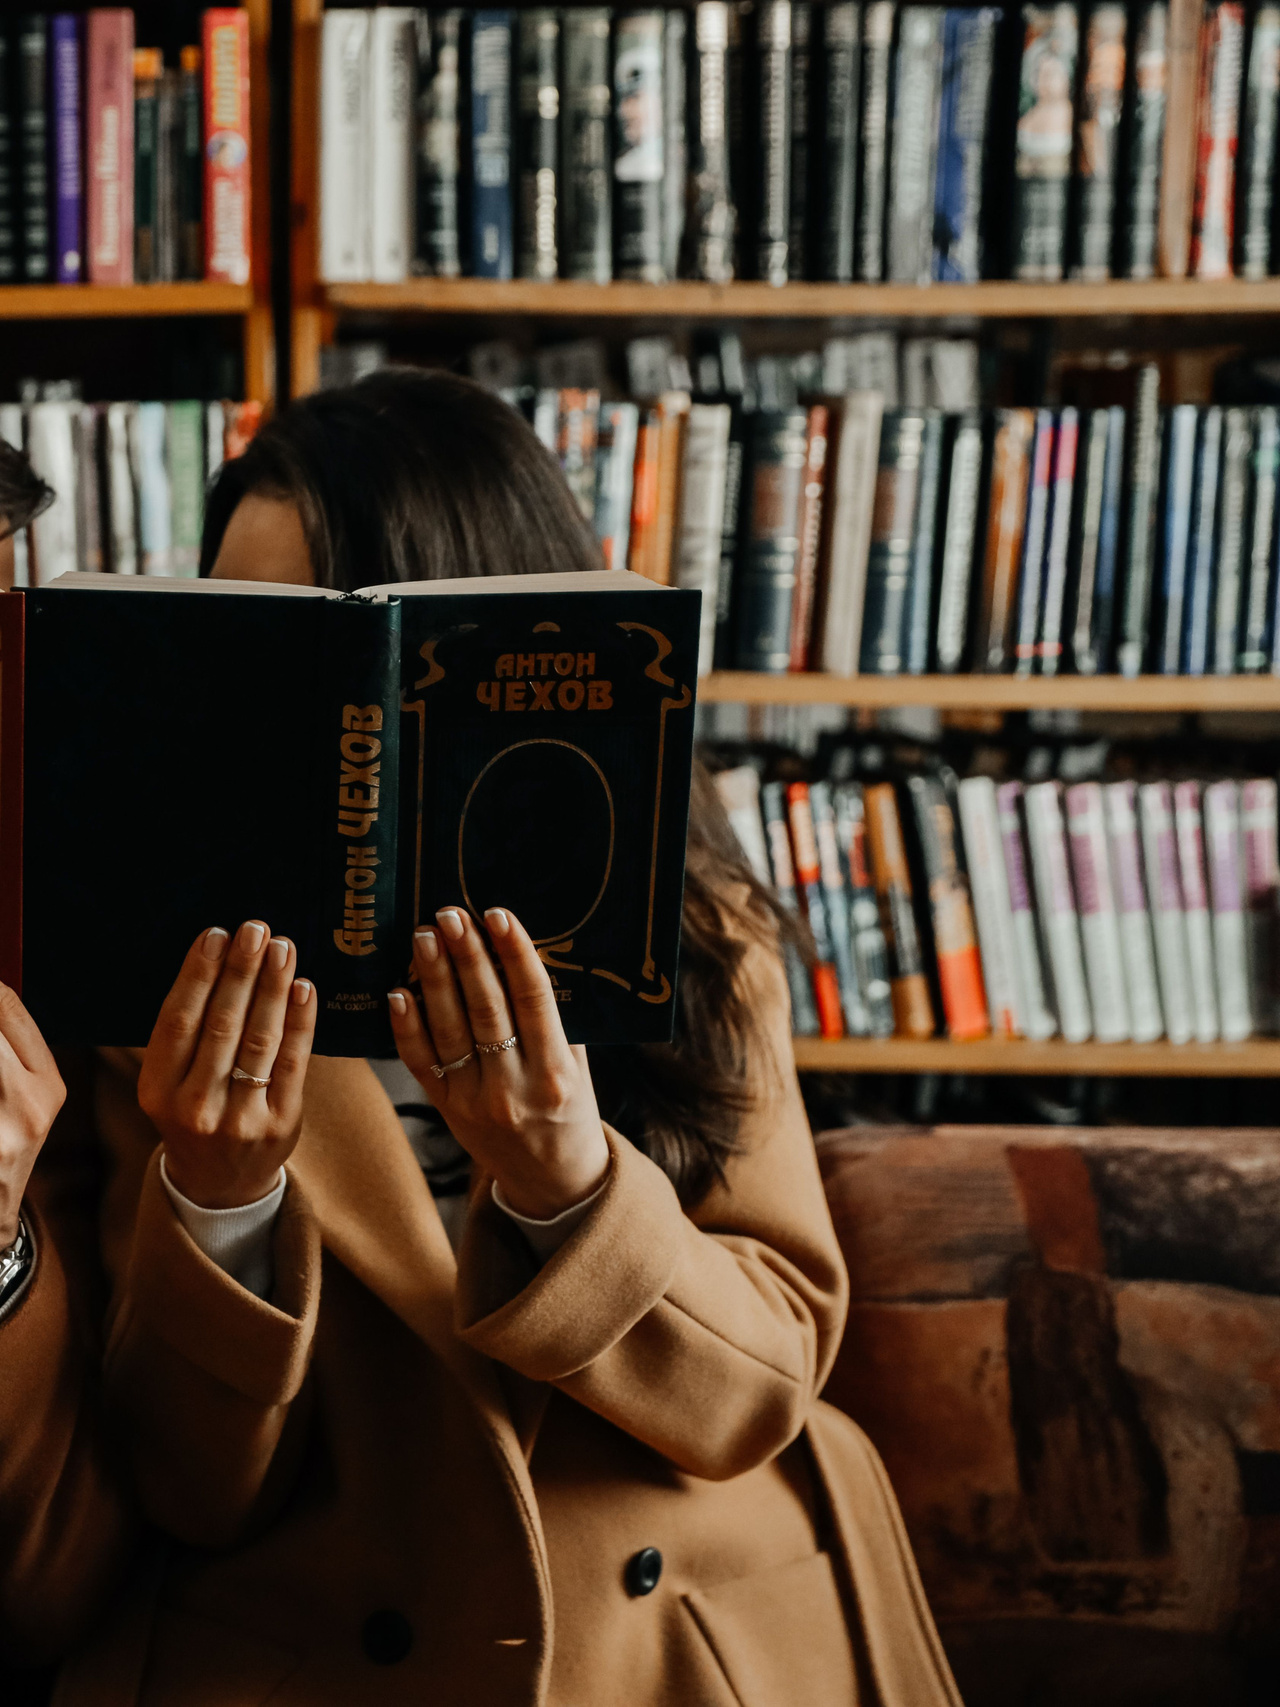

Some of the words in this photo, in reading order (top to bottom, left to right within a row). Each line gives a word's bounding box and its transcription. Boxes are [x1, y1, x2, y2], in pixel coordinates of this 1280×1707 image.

[495, 652, 596, 678] АНТОН
[476, 679, 614, 712] ЧЕХОВ
[337, 704, 383, 838] ЧЕХОВ
[333, 845, 382, 957] АНТОН
[327, 1000, 342, 1010] НА
